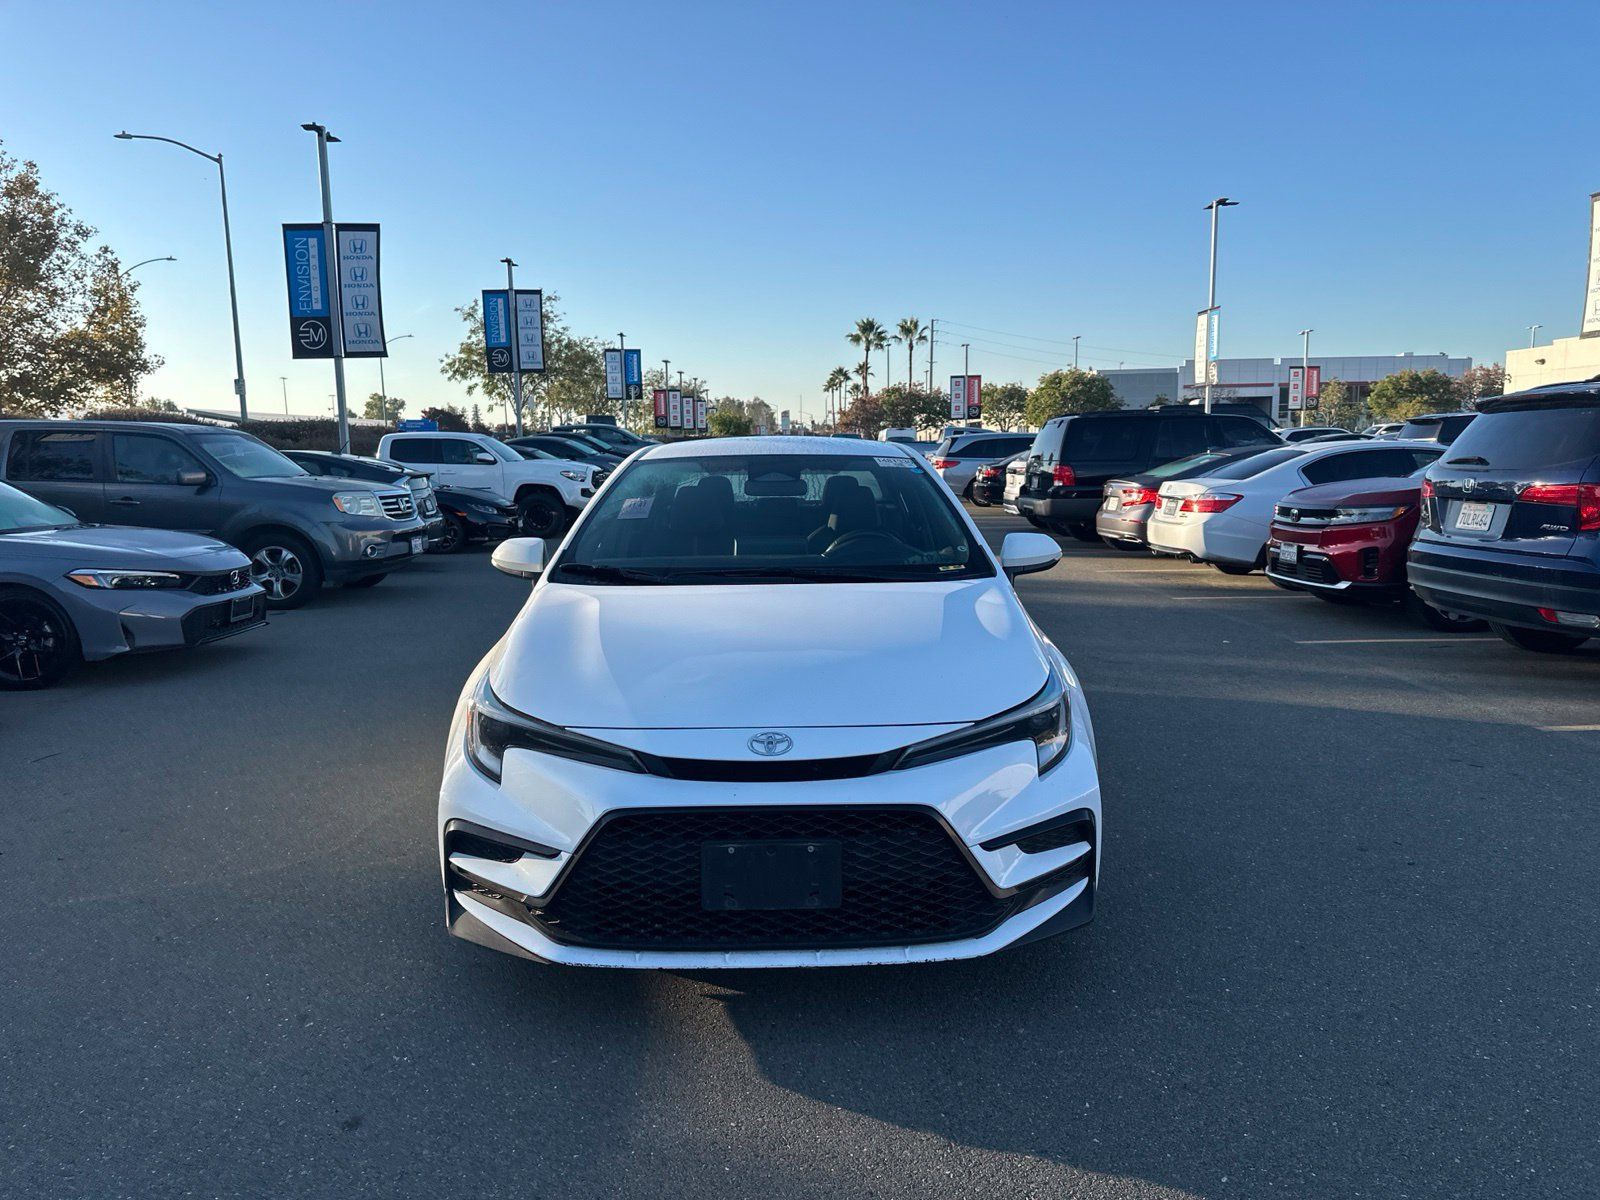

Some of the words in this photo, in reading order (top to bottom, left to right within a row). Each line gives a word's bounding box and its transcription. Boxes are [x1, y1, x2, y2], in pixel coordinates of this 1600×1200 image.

[294, 237, 312, 311] ENVISION
[489, 297, 500, 343] ENVISION
[1540, 523, 1570, 532] AWD
